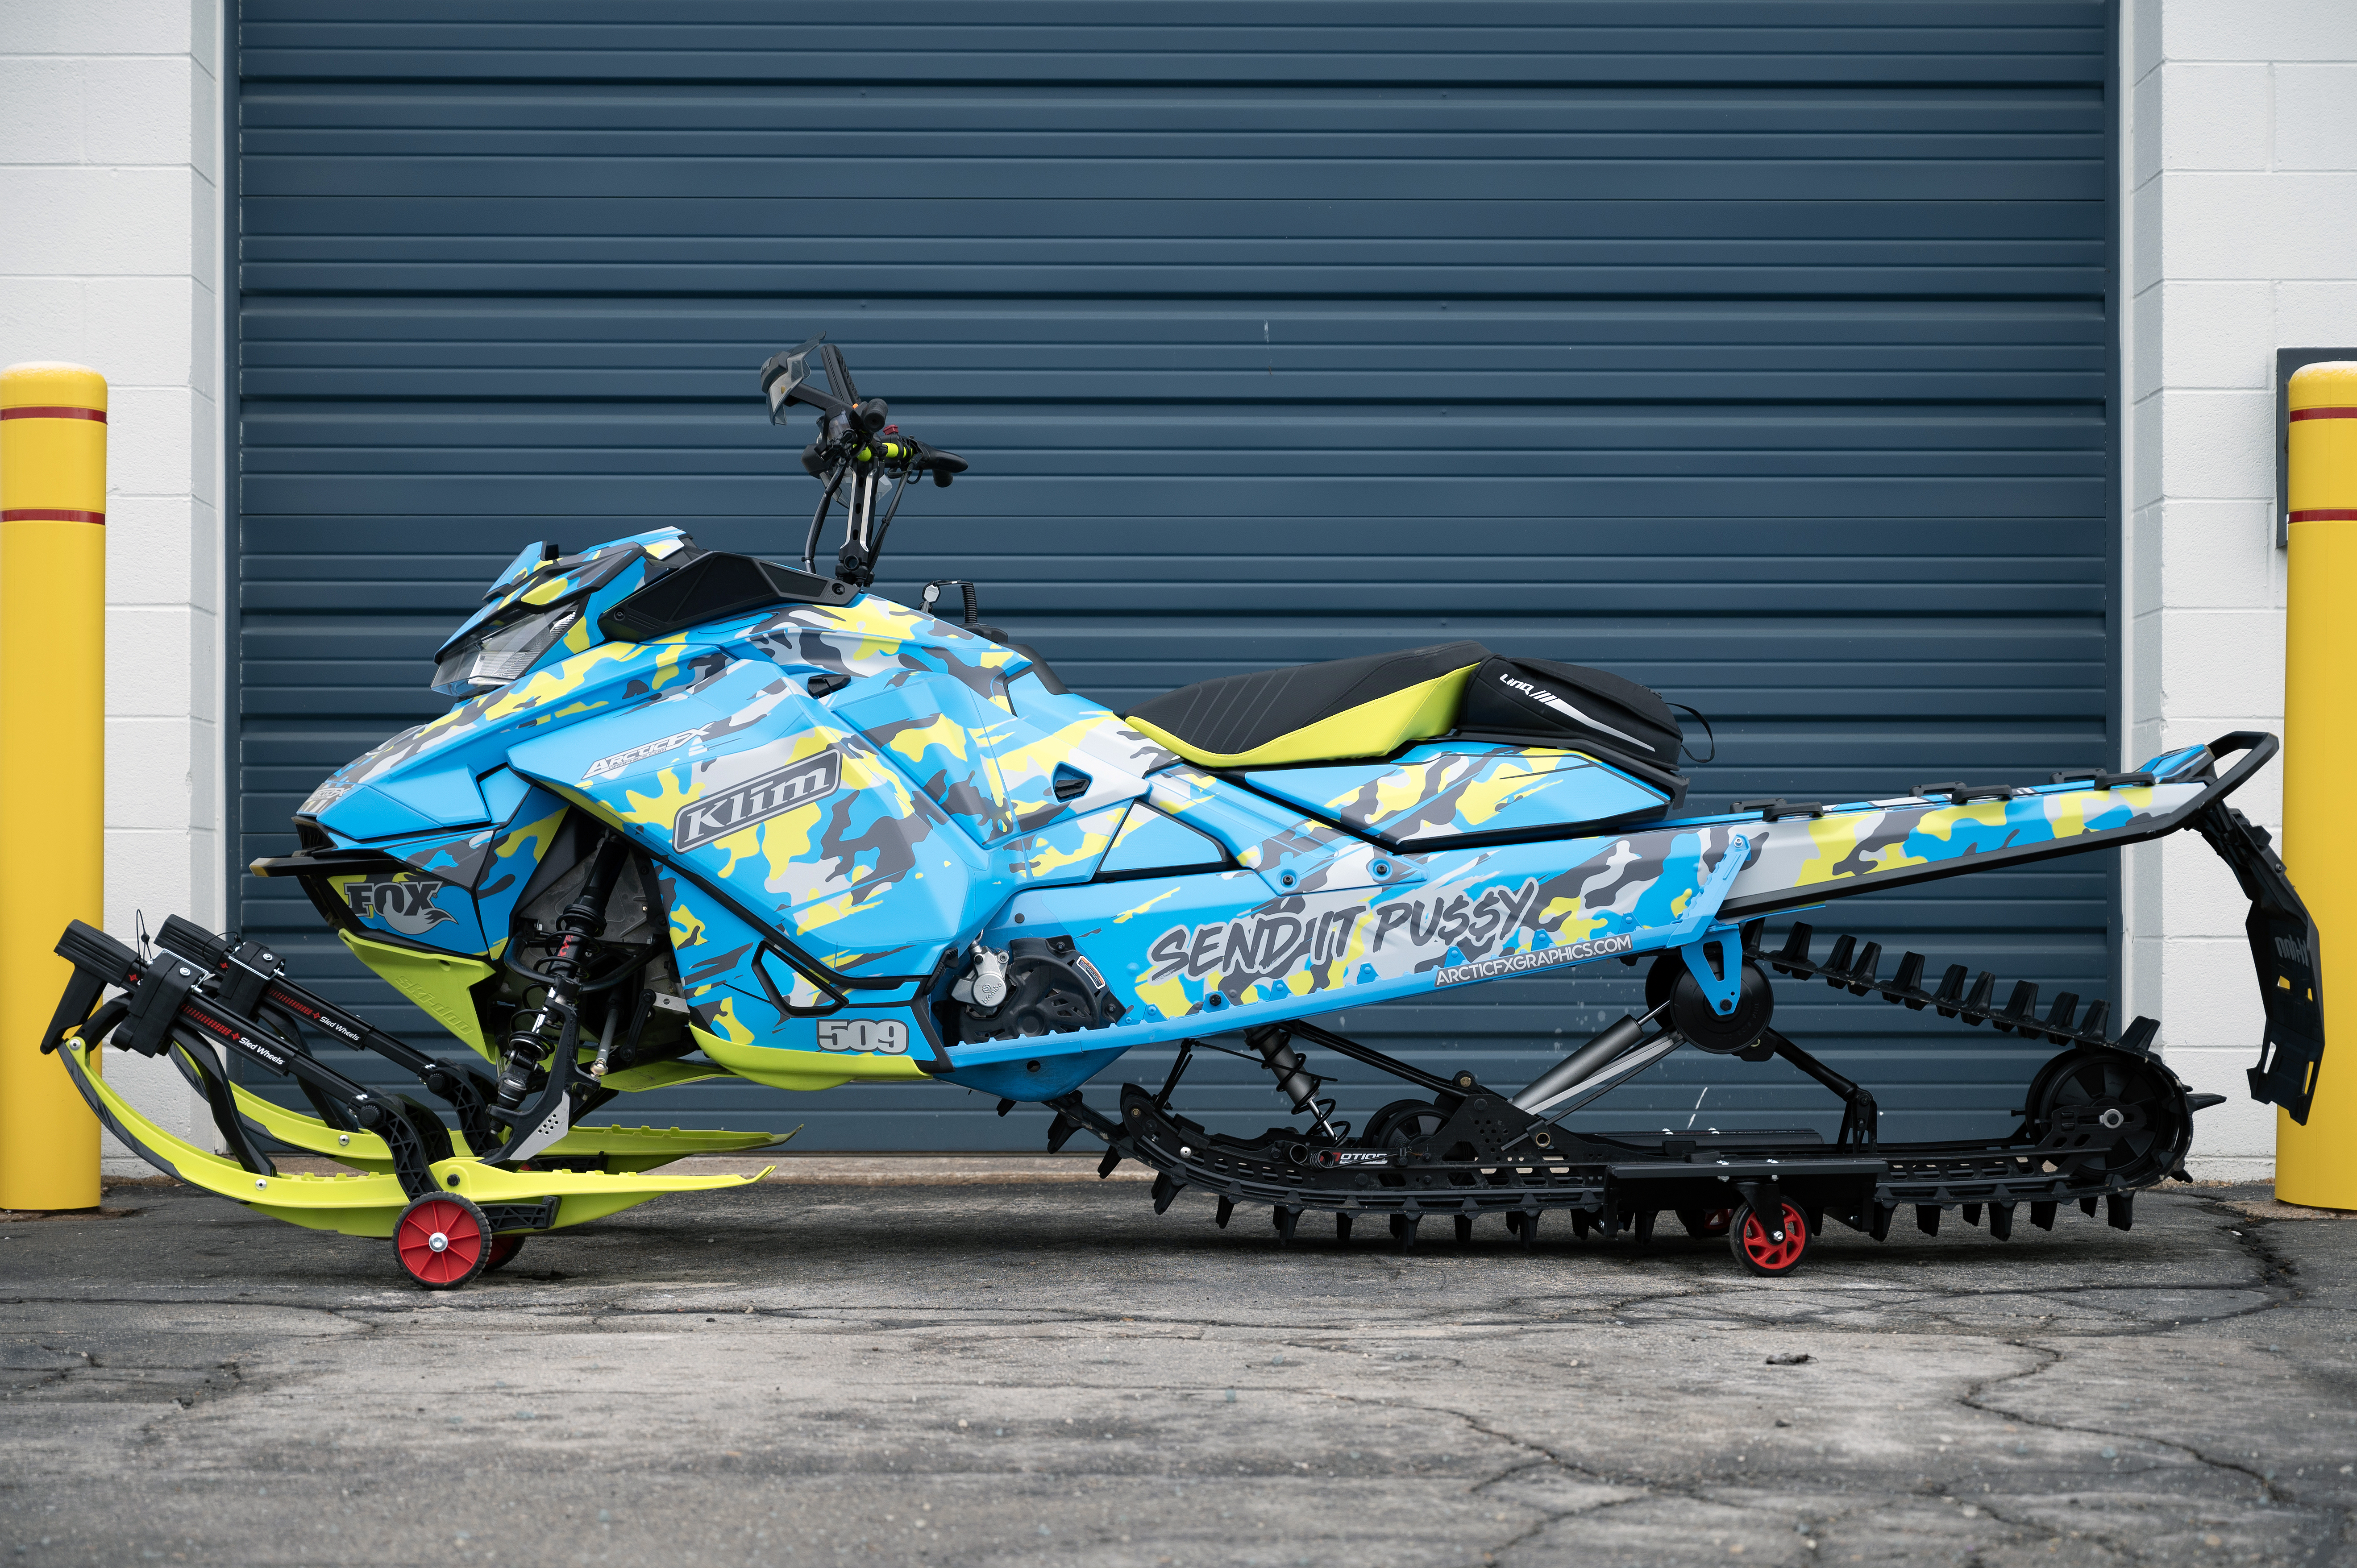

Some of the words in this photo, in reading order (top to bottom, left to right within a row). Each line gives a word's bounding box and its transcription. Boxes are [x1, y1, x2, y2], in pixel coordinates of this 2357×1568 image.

[344, 881, 443, 917] FOX
[1436, 935, 1632, 986] ARCTICFXGRAPHICS.COM
[395, 975, 474, 1035] ski-doo
[981, 982, 1002, 1004] brembo
[319, 1016, 337, 1028] Sled
[335, 1024, 360, 1041] Wheels
[818, 1020, 908, 1054] 509
[239, 1037, 258, 1050] Sled
[257, 1046, 284, 1065] Wheels
